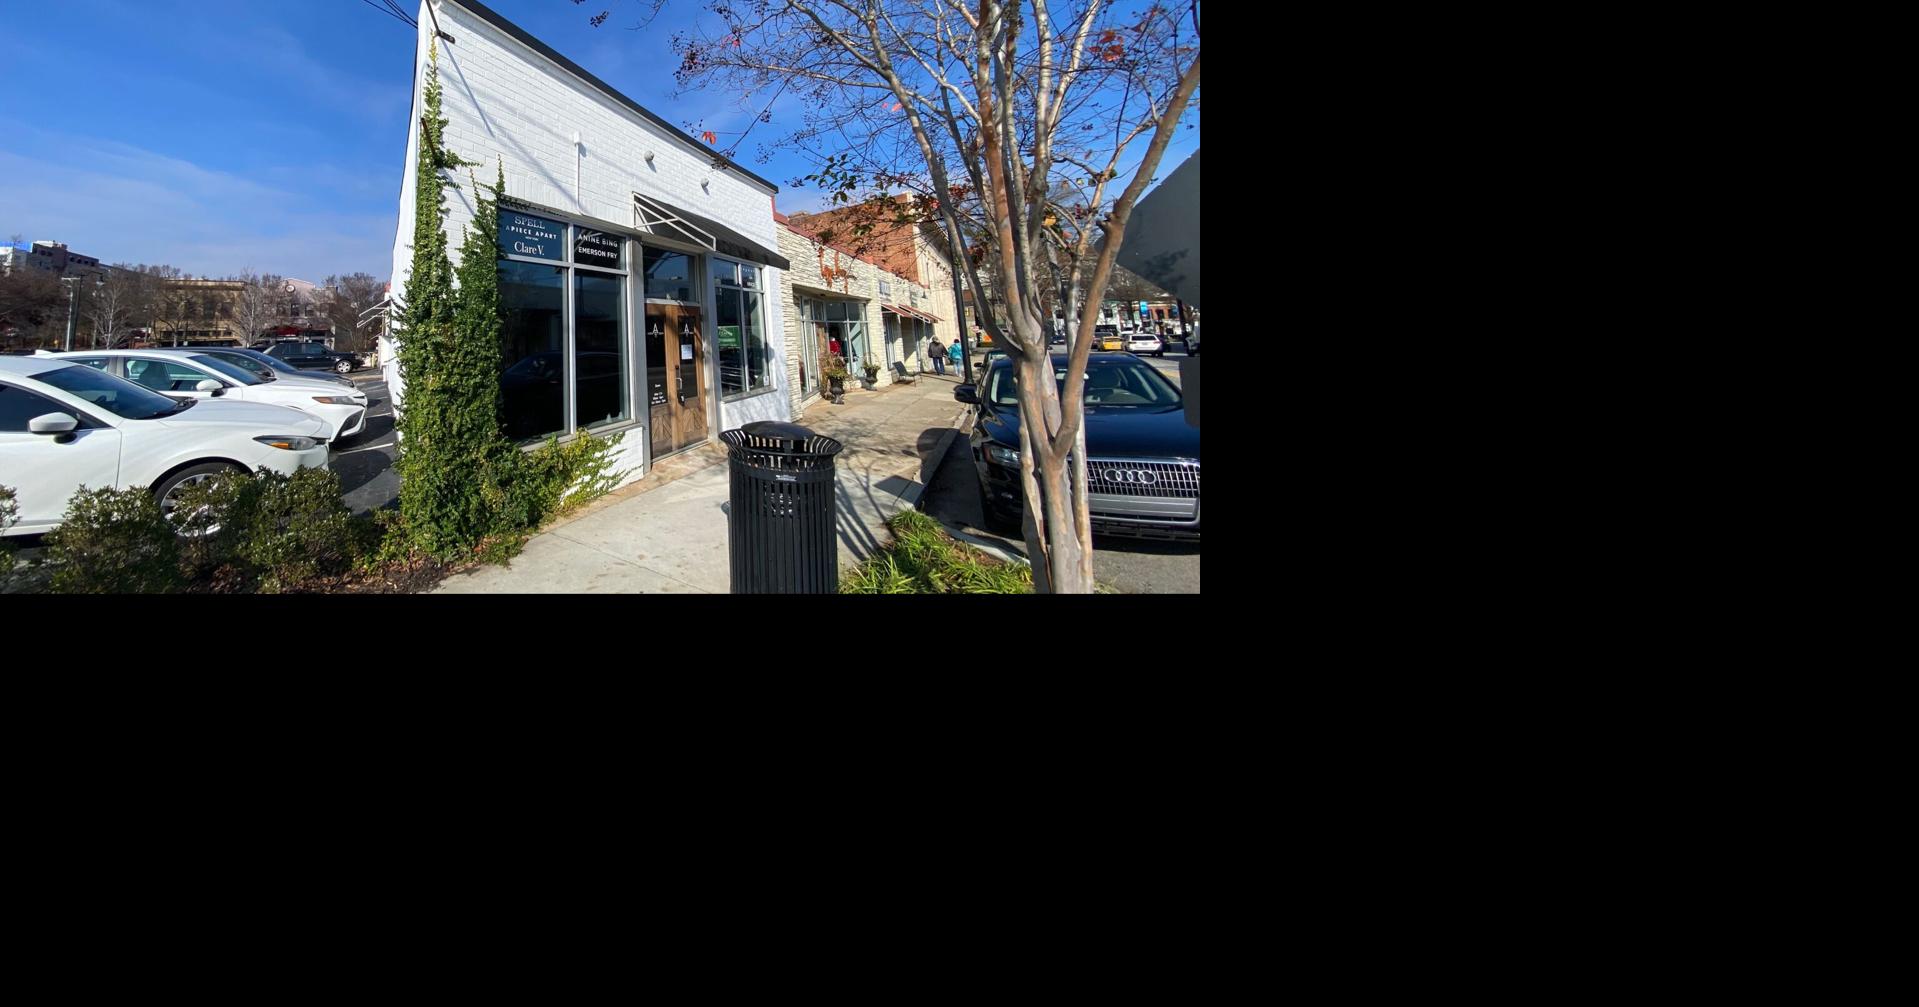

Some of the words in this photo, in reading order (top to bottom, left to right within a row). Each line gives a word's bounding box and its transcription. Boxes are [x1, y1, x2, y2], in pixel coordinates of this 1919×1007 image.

[514, 215, 546, 230] SPELL
[535, 231, 557, 240] APART
[577, 233, 600, 245] ANINE
[602, 238, 618, 248] BING
[514, 241, 537, 255] Clare
[537, 244, 545, 256] V.
[578, 246, 606, 257] EMERSON
[607, 251, 618, 259] FRY
